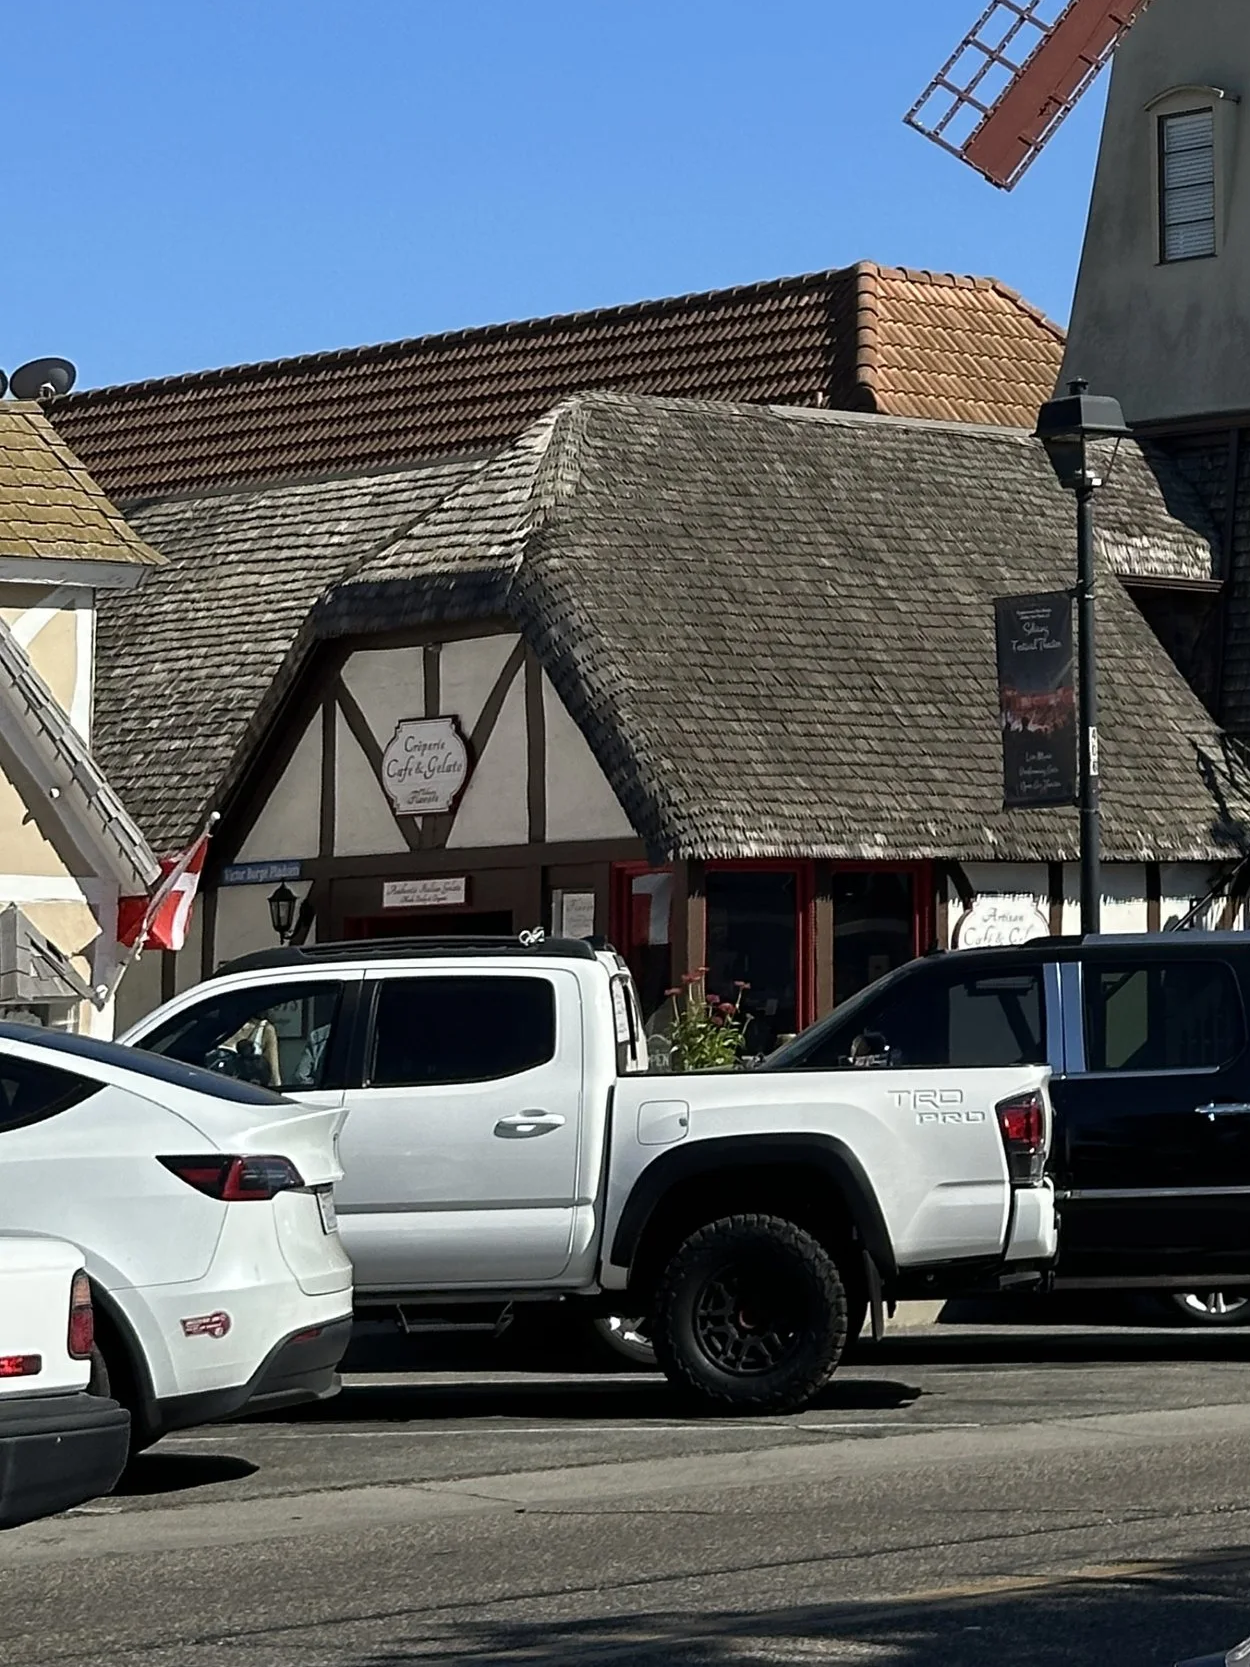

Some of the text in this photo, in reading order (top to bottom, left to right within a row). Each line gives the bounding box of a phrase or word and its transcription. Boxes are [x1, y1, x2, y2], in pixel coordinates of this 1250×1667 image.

[415, 761, 424, 775] &
[423, 751, 463, 780] Gelato
[982, 907, 1024, 923] Artisan
[649, 1053, 670, 1067] PEN
[886, 1088, 964, 1110] TRD
[916, 1110, 986, 1125] PRO
